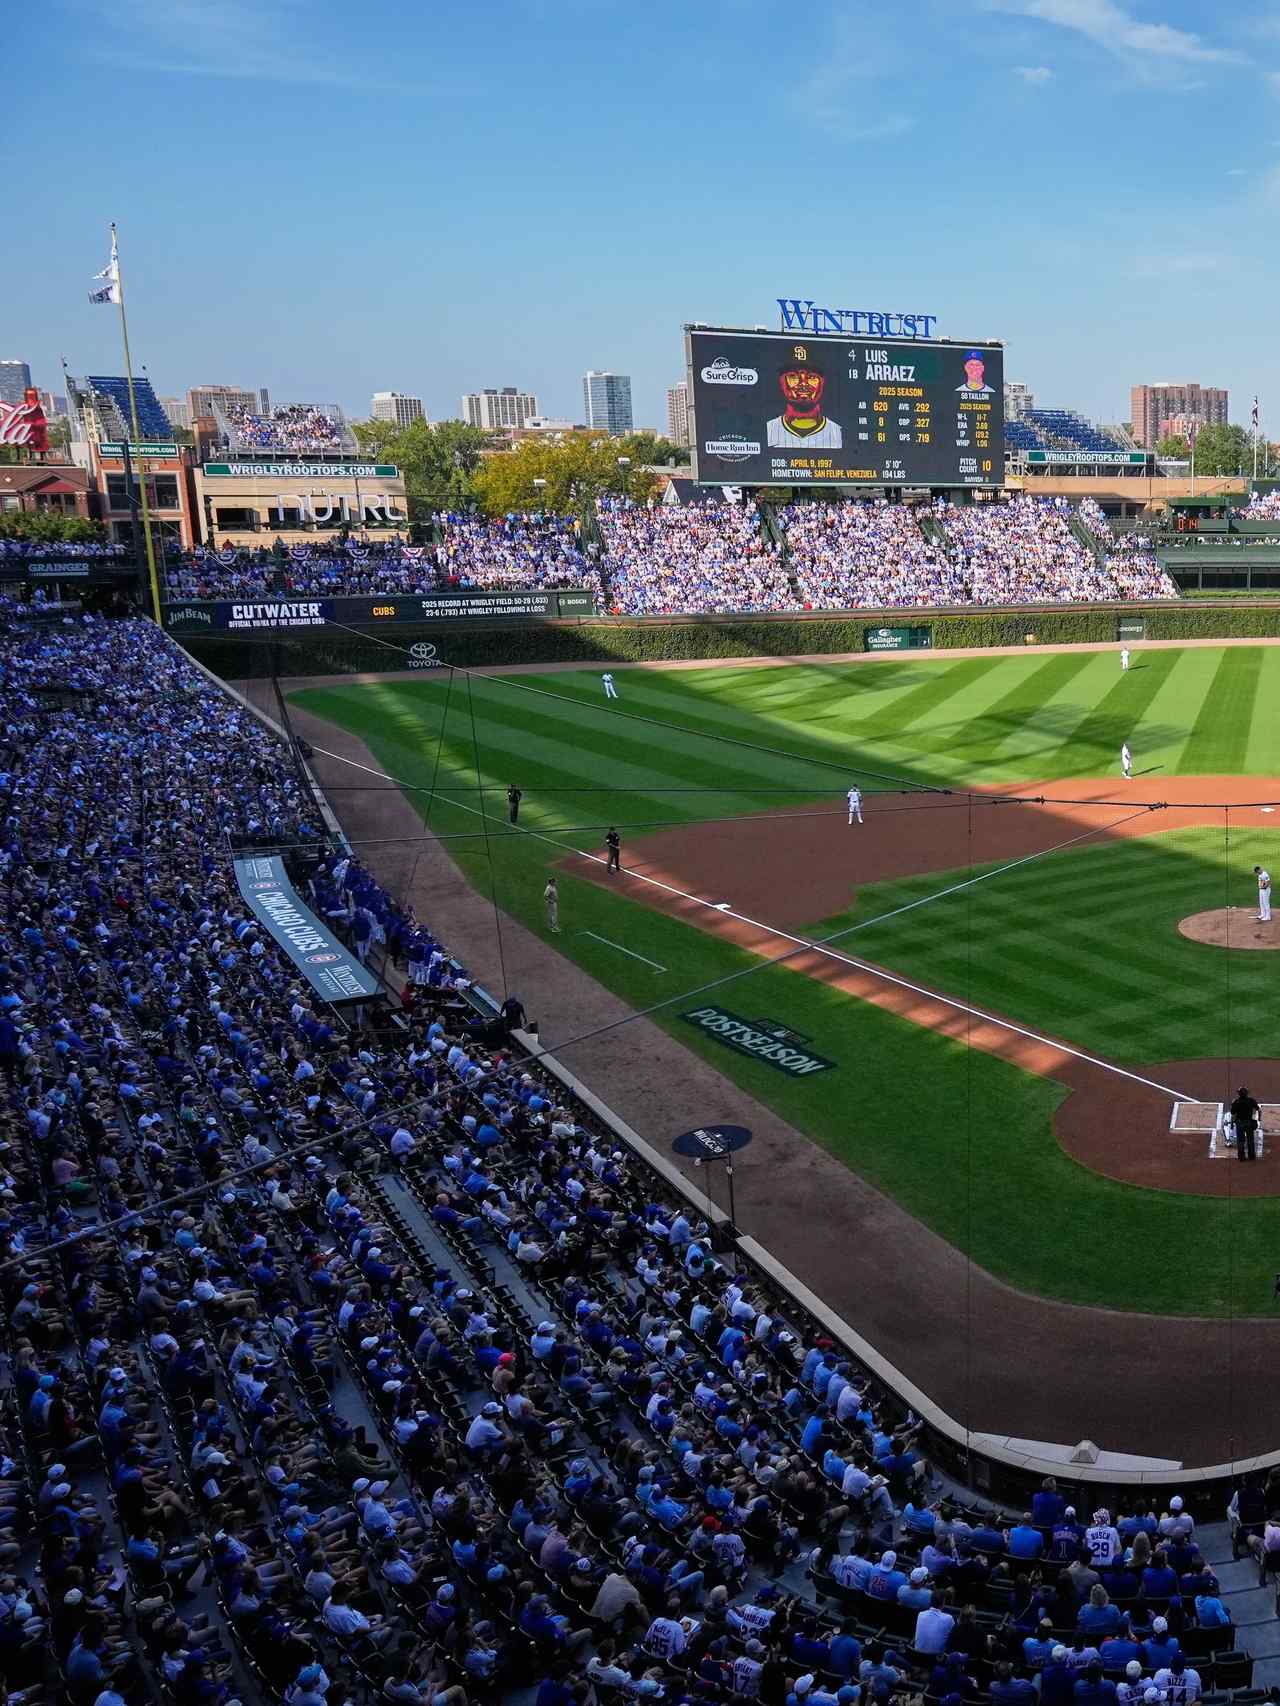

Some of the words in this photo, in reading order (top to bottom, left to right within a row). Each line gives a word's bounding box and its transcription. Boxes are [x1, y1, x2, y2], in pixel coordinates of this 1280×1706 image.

[776, 299, 937, 338] WINTRUST
[865, 349, 888, 363] LUIS
[866, 364, 915, 382] ARRAEZ
[879, 387, 896, 396] 2025
[897, 388, 923, 398] SEASON
[873, 401, 888, 411] 620
[707, 443, 730, 453] Home
[790, 458, 810, 468] APRIL
[817, 459, 833, 468] 1997
[959, 458, 977, 466] PITCH
[982, 460, 992, 472] 10
[228, 464, 377, 476] WRIGLEYROOFTOPS.COM
[772, 469, 813, 478] HOMETOWN:
[814, 469, 826, 478] SAN
[894, 470, 906, 479] LBS
[959, 466, 978, 474] COUNT
[28, 563, 89, 572] GRAINGER
[421, 600, 438, 609] 2025
[438, 600, 461, 608] RECORD
[461, 599, 470, 608] AT
[470, 599, 496, 607] WRIGLEY
[495, 598, 514, 606] FIELD:
[232, 603, 320, 620] CUTWATER
[372, 606, 396, 617] CUBS
[459, 607, 467, 616] AT
[467, 607, 494, 615] WRIGLEY
[493, 606, 526, 615] FOLLOWING
[526, 605, 531, 613] A
[531, 605, 546, 613] LOSS
[168, 611, 186, 626] JIM
[185, 607, 212, 624] BEAM
[228, 619, 251, 628] OFFICIAL
[278, 618, 288, 627] THE
[408, 659, 442, 669] TOYOTA
[255, 891, 307, 927] CHICAGO
[283, 925, 329, 954] CUBS
[686, 1008, 825, 1074] POSTSEASON
[1088, 1542, 1110, 1558] 29
